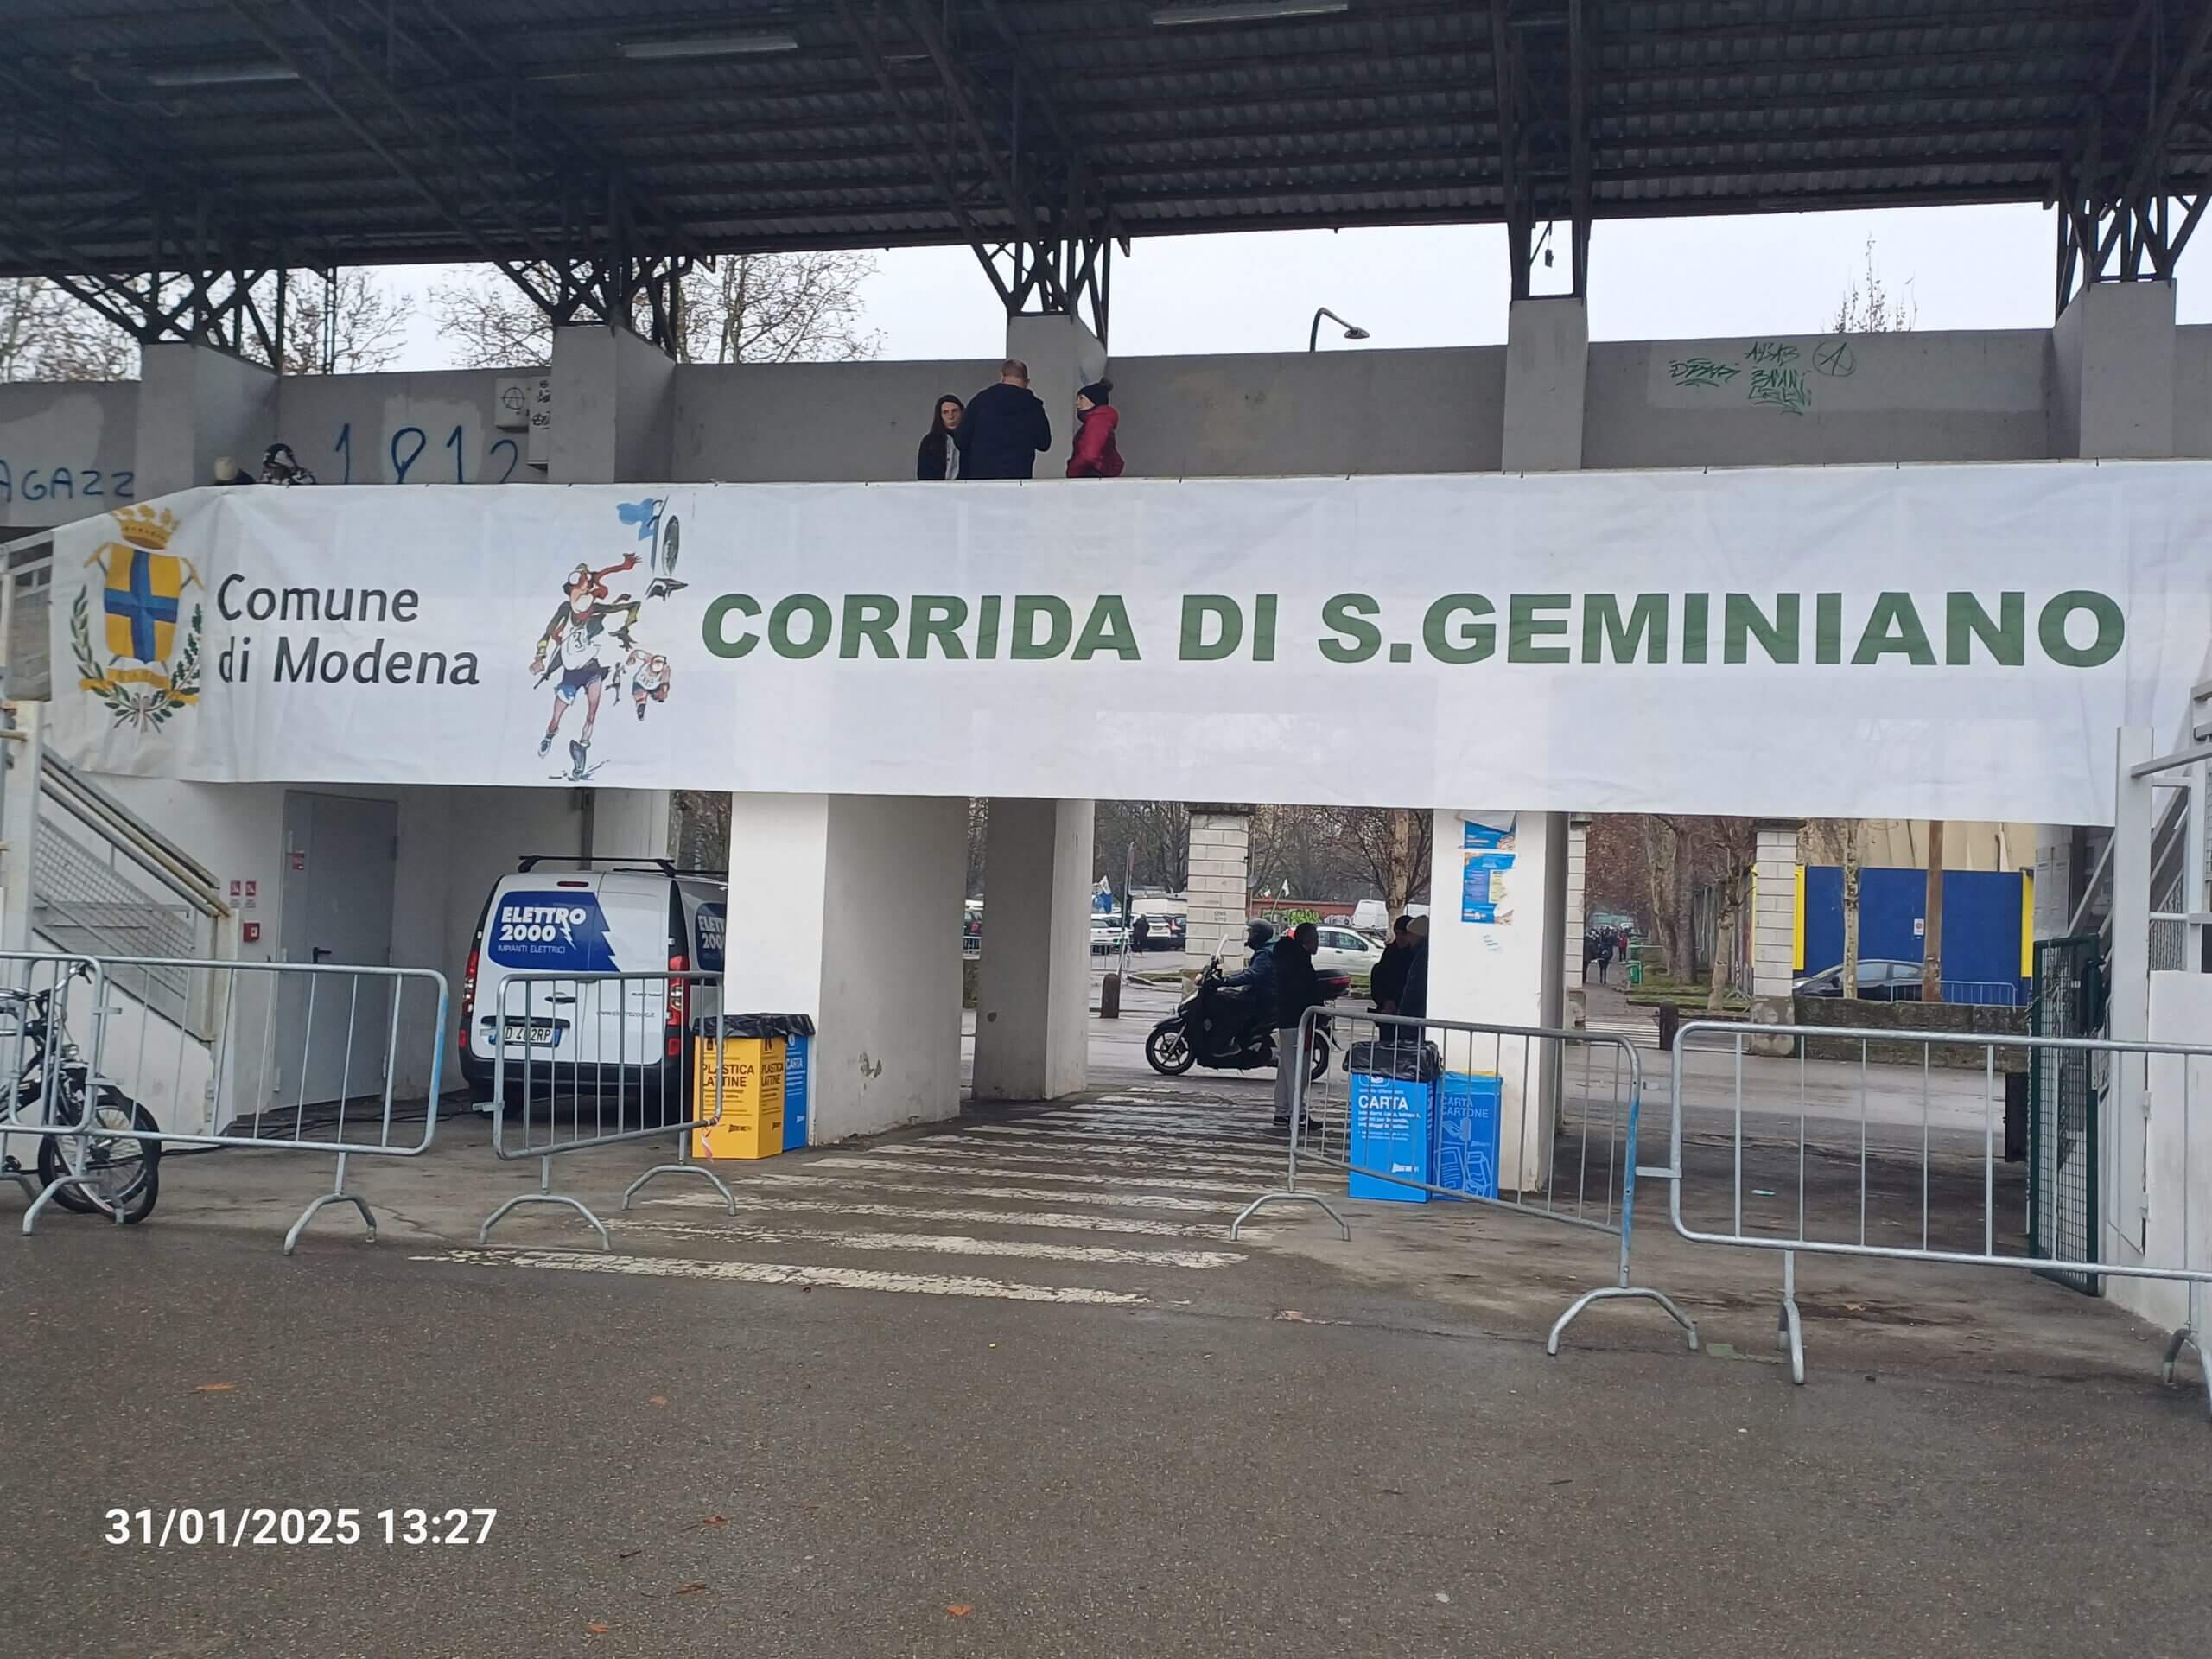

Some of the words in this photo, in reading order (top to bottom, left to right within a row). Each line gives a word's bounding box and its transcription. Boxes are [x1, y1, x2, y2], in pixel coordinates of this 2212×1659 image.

[217, 573, 419, 622] Comune
[702, 593, 1141, 661] CORRIDA
[1179, 593, 1279, 663] DI
[1318, 589, 2126, 667] S.GEMINIANO
[219, 635, 251, 683] di
[273, 636, 480, 685] Modena
[501, 906, 587, 925] ELETTRO
[499, 924, 556, 943] 2000
[530, 945, 566, 955] ELETTRICI
[702, 1063, 754, 1075] PLSTICA
[1358, 1094, 1409, 1111] CARTA
